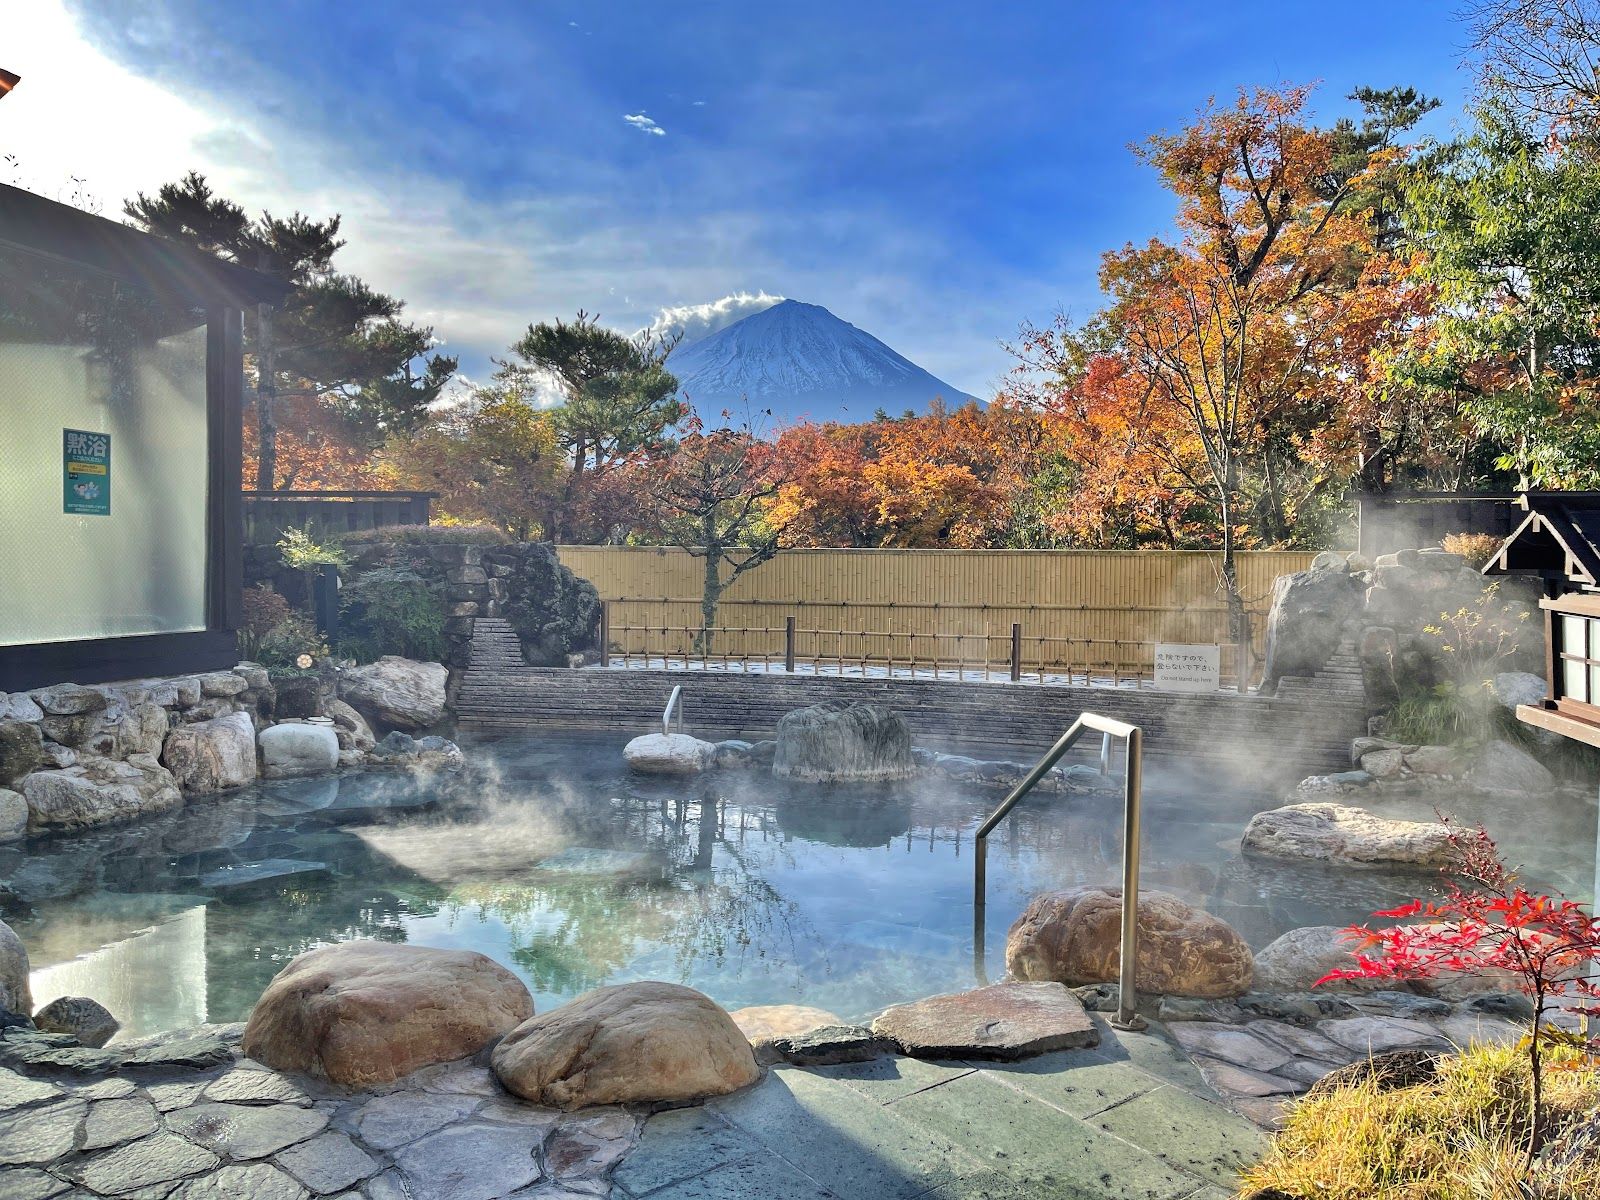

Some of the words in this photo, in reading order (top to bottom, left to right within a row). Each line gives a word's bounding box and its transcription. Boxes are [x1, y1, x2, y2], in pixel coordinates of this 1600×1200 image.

[67, 433, 107, 457] 黙浴
[1157, 653, 1208, 663] 危険ですので、
